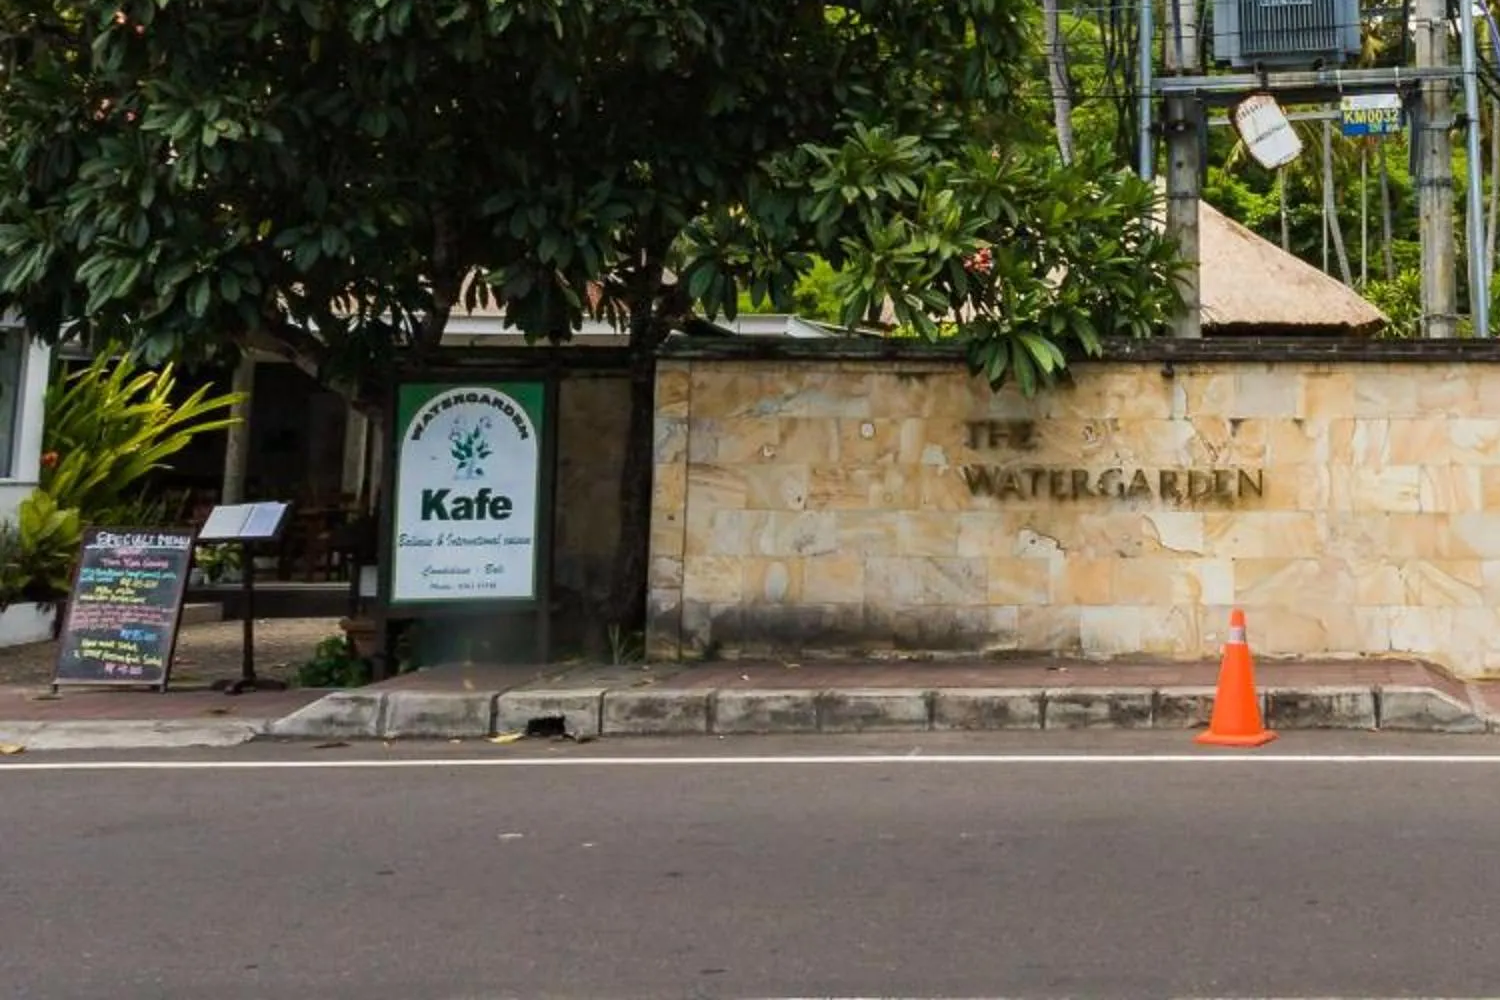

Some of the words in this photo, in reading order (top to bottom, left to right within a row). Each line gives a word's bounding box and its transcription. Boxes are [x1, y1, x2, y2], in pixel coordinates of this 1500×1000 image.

[411, 392, 529, 440] WATERGARDEN
[964, 418, 1036, 450] THE
[963, 465, 1264, 500] WATERGARDEN
[421, 488, 513, 521] Kafe
